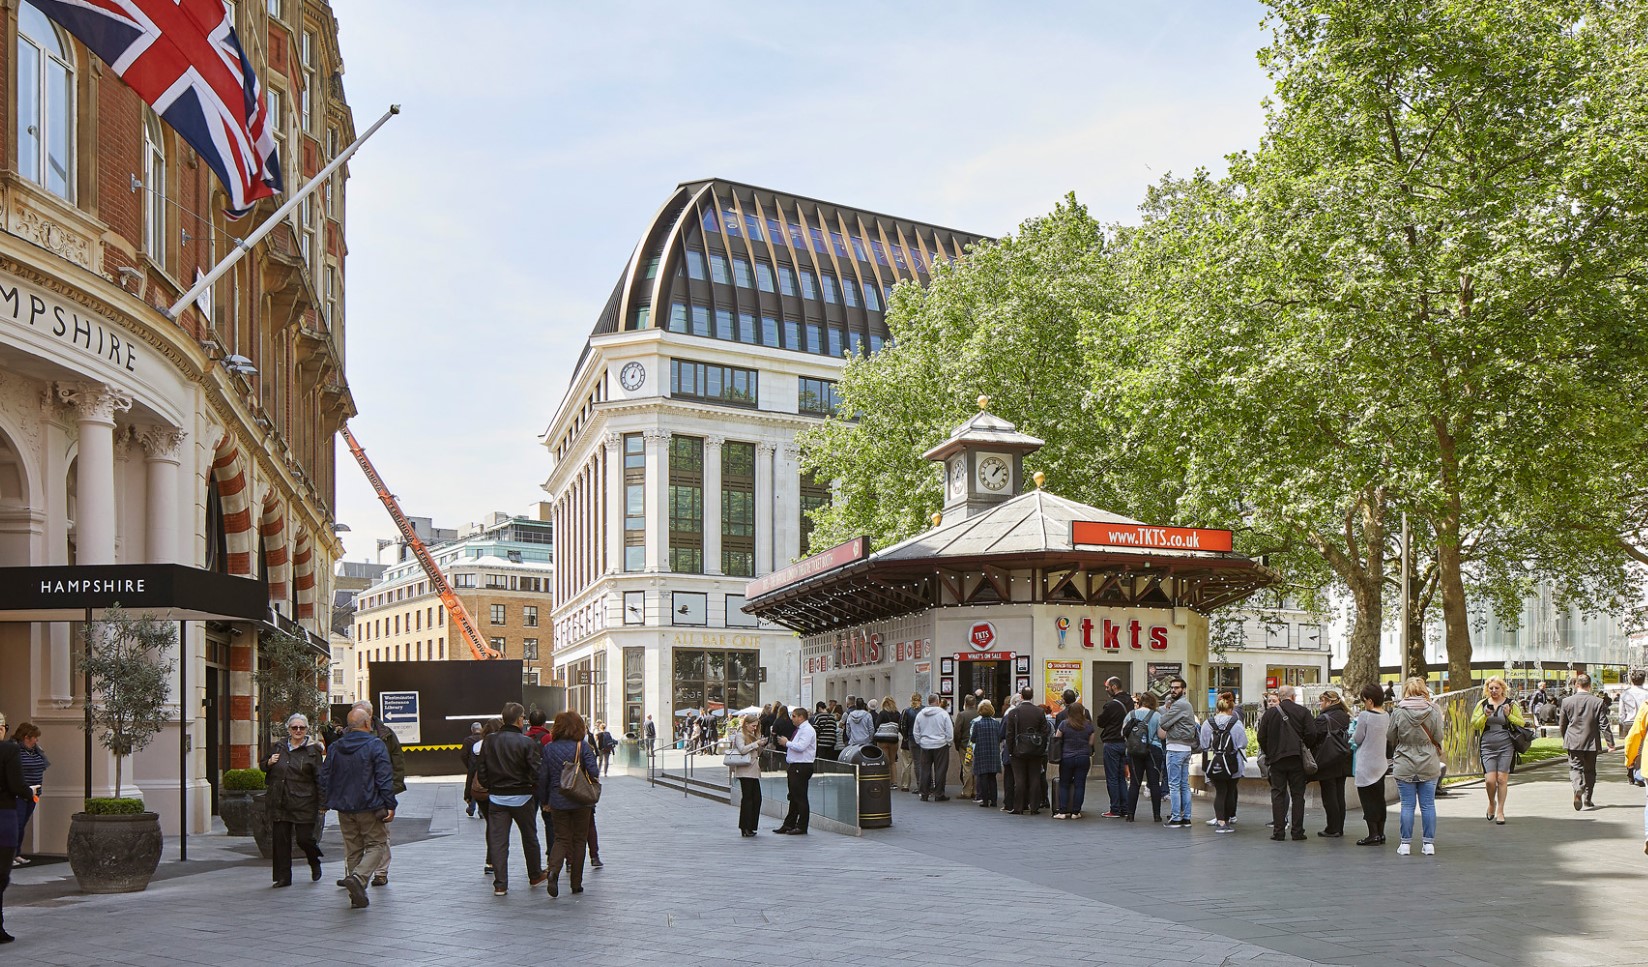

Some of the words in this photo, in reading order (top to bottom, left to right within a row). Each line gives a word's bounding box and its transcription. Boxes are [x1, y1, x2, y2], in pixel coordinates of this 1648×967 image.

[388, 501, 415, 543] TERRANOVA
[1108, 527, 1200, 548] www.TKTS.co.uk
[416, 547, 446, 593] TERRANOVA
[40, 579, 145, 594] HAMPSHIRE
[460, 616, 487, 658] TERRANOVA
[673, 632, 695, 646] ALL
[702, 632, 727, 646] BAR
[732, 633, 761, 648] ONE
[974, 630, 990, 641] TKTS
[1080, 617, 1168, 651] tkts
